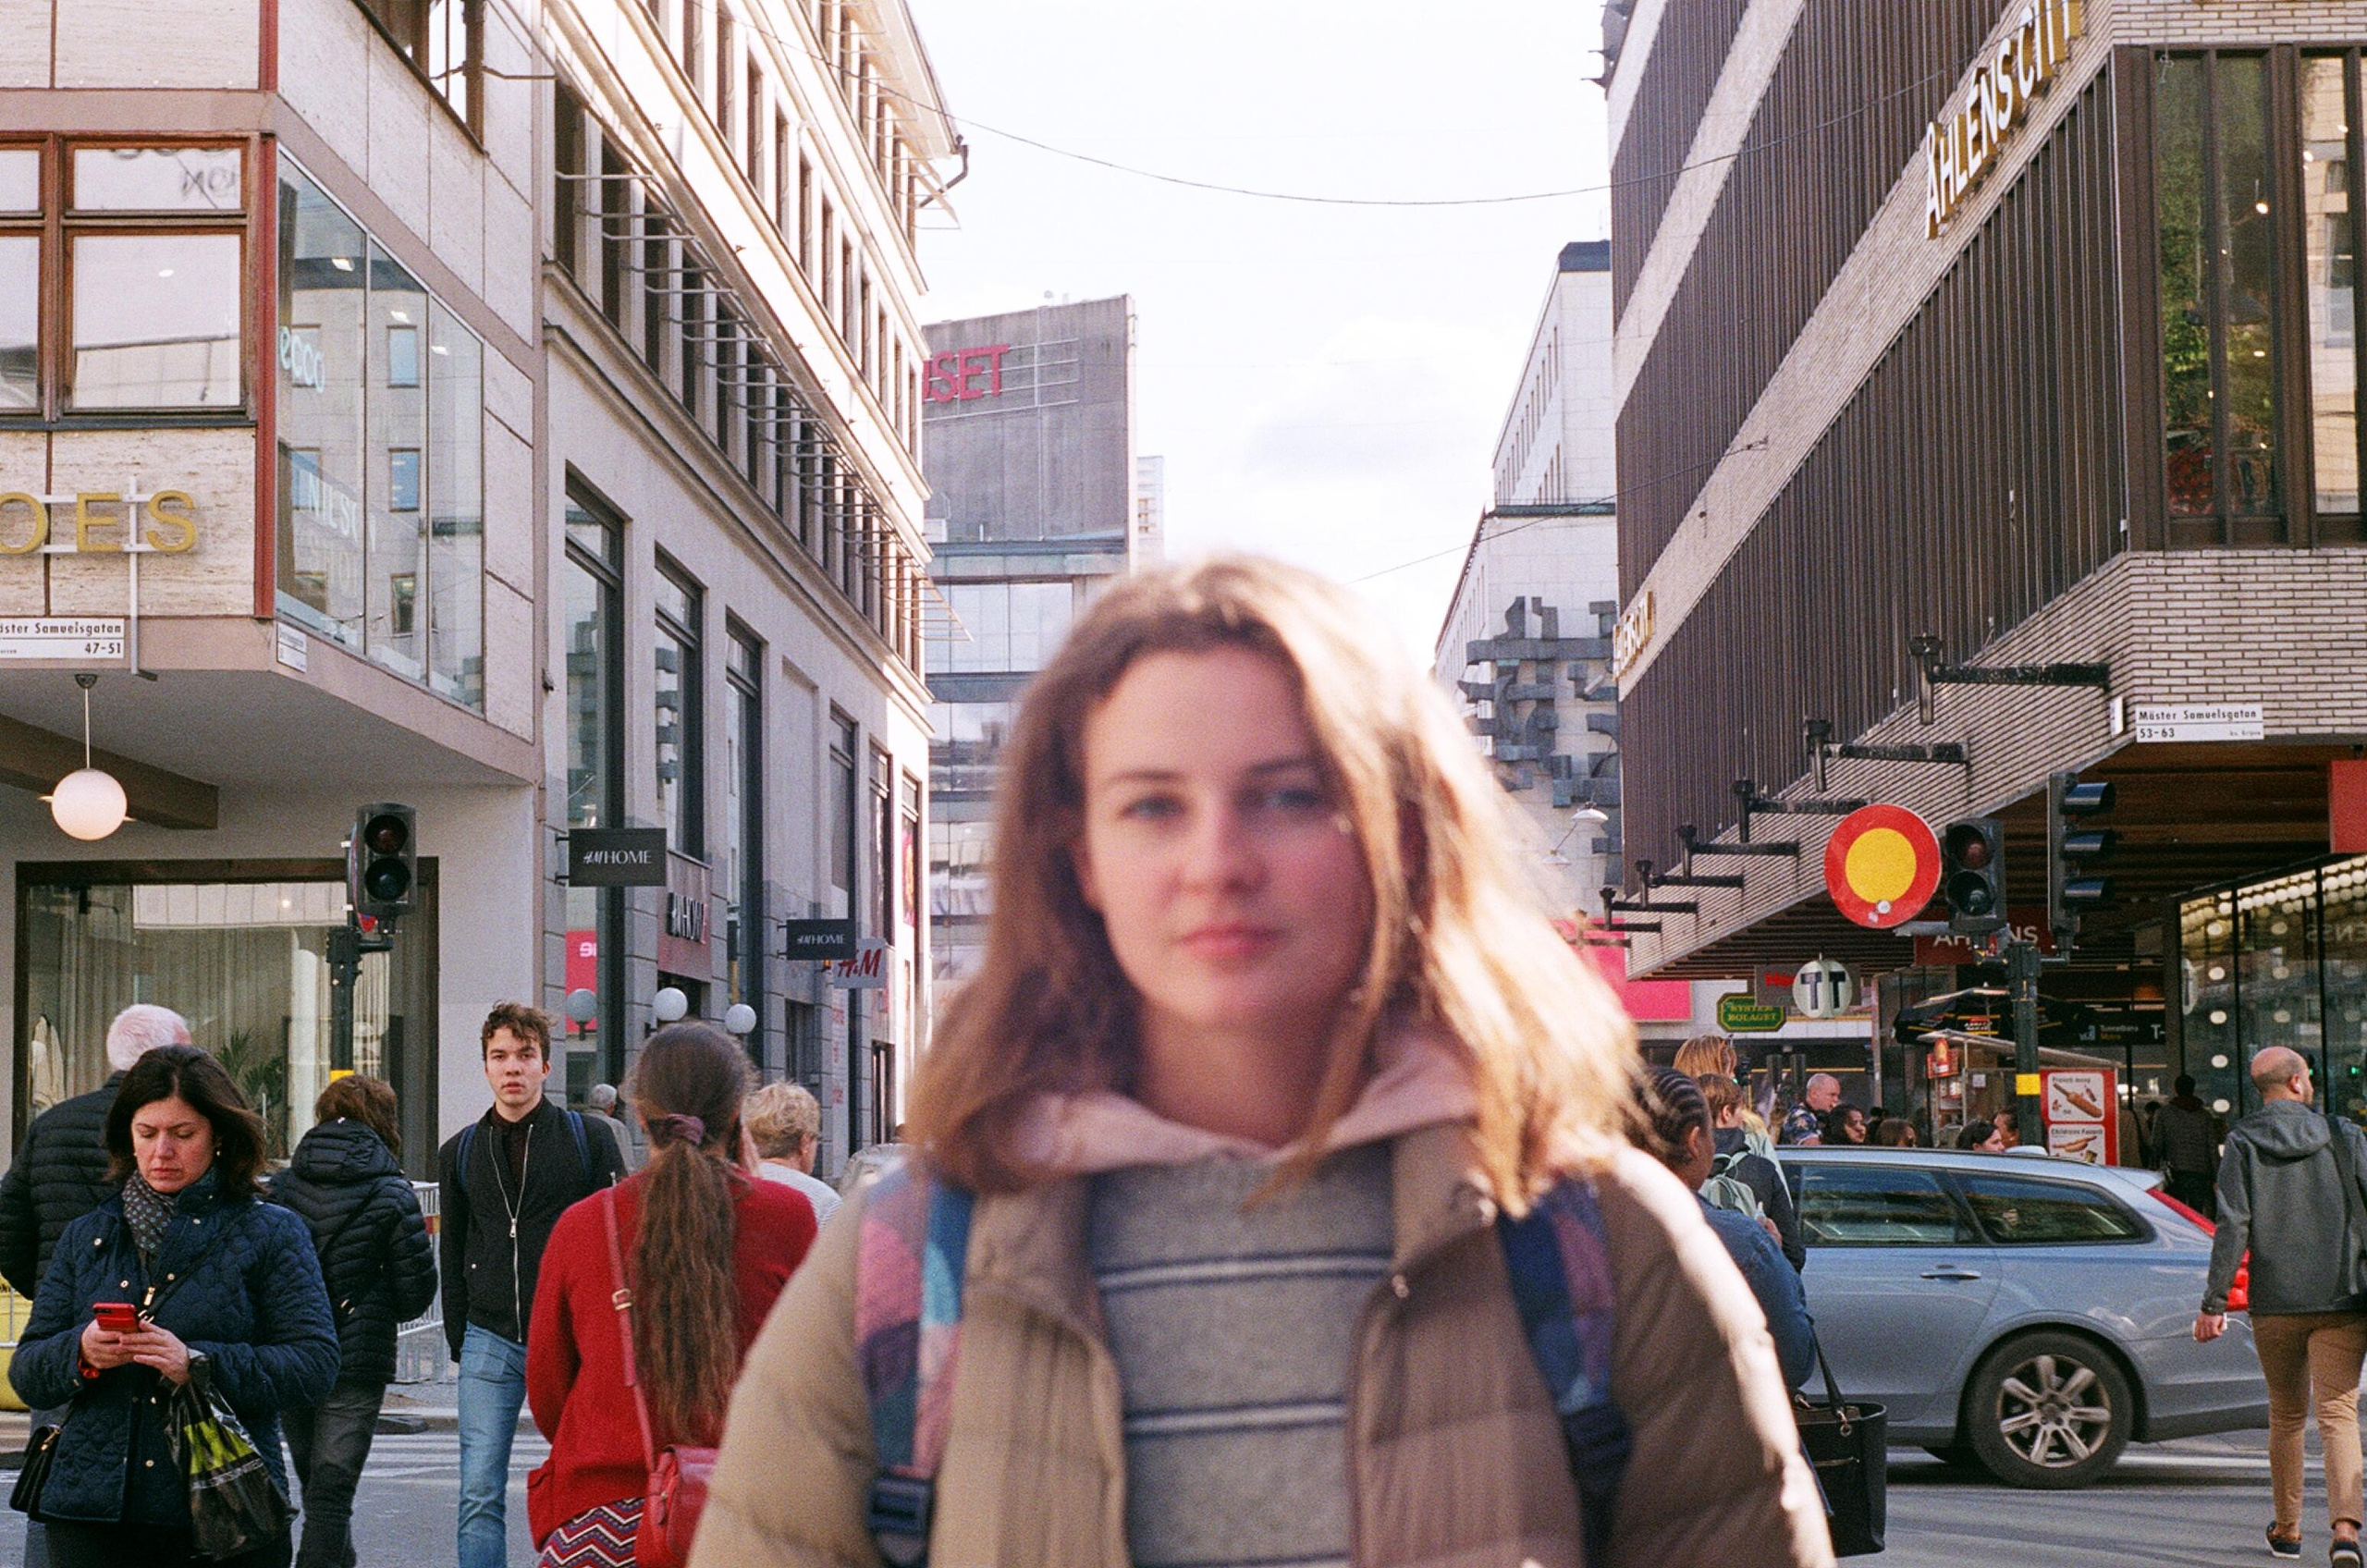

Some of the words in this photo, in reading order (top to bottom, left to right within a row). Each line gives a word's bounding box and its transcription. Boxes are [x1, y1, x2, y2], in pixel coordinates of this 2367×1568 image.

[279, 325, 325, 394] ecco
[35, 621, 122, 637] Samuelsgatan
[84, 643, 122, 655] 47-51
[2183, 708, 2257, 721] Samuelsgatan
[2140, 728, 2175, 738] 53-63
[604, 850, 653, 864] HOME
[838, 949, 882, 978] H&M
